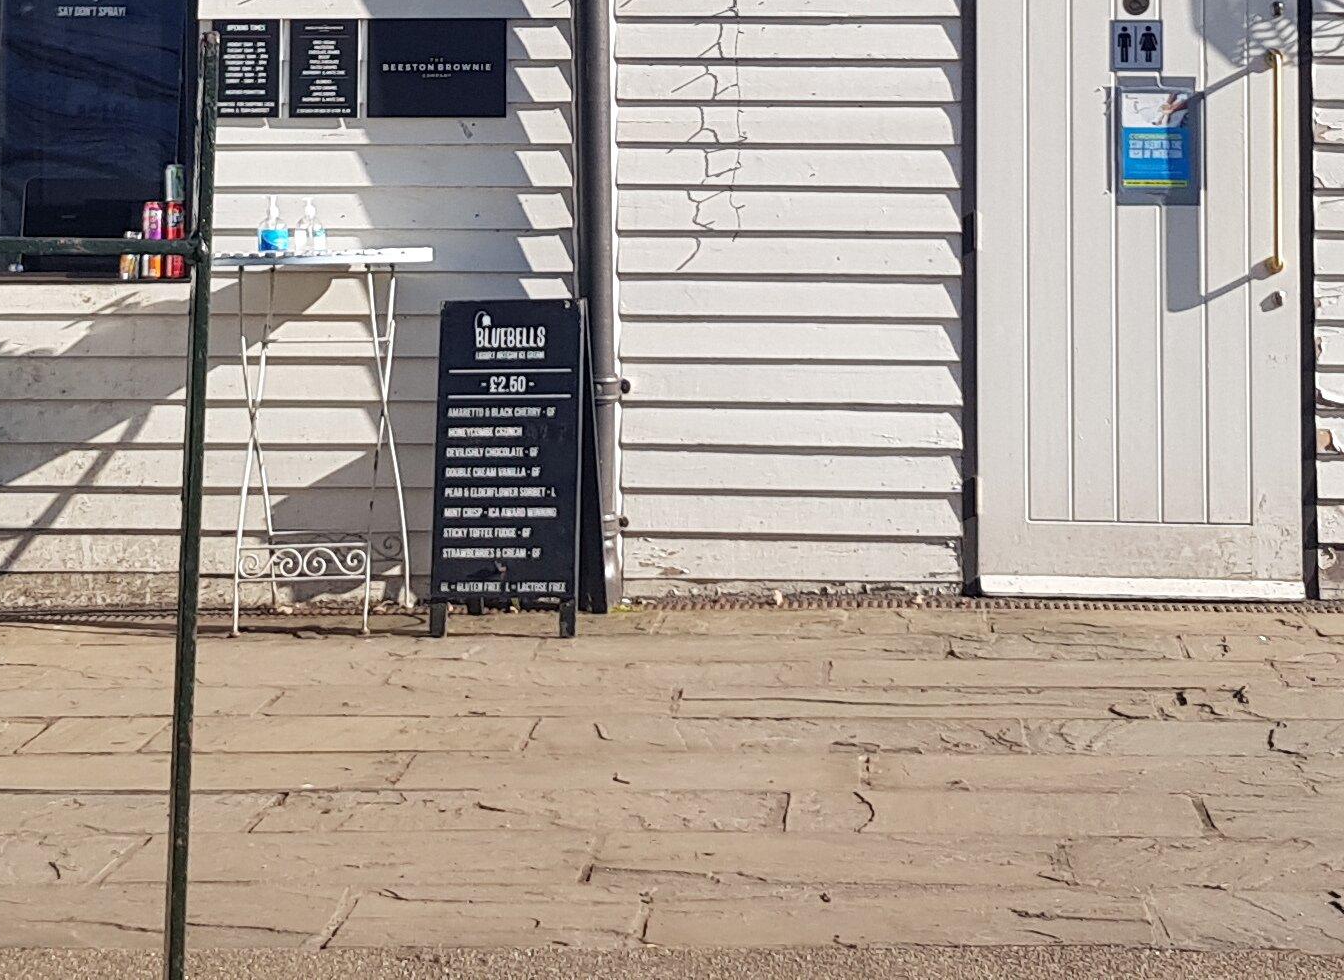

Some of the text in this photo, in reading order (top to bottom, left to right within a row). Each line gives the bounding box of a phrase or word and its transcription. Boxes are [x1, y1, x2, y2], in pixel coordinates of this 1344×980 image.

[382, 63, 493, 71] BEESTON BROWNIE
[475, 326, 546, 348] BLUEBELLS
[489, 376, 527, 393] £2.50
